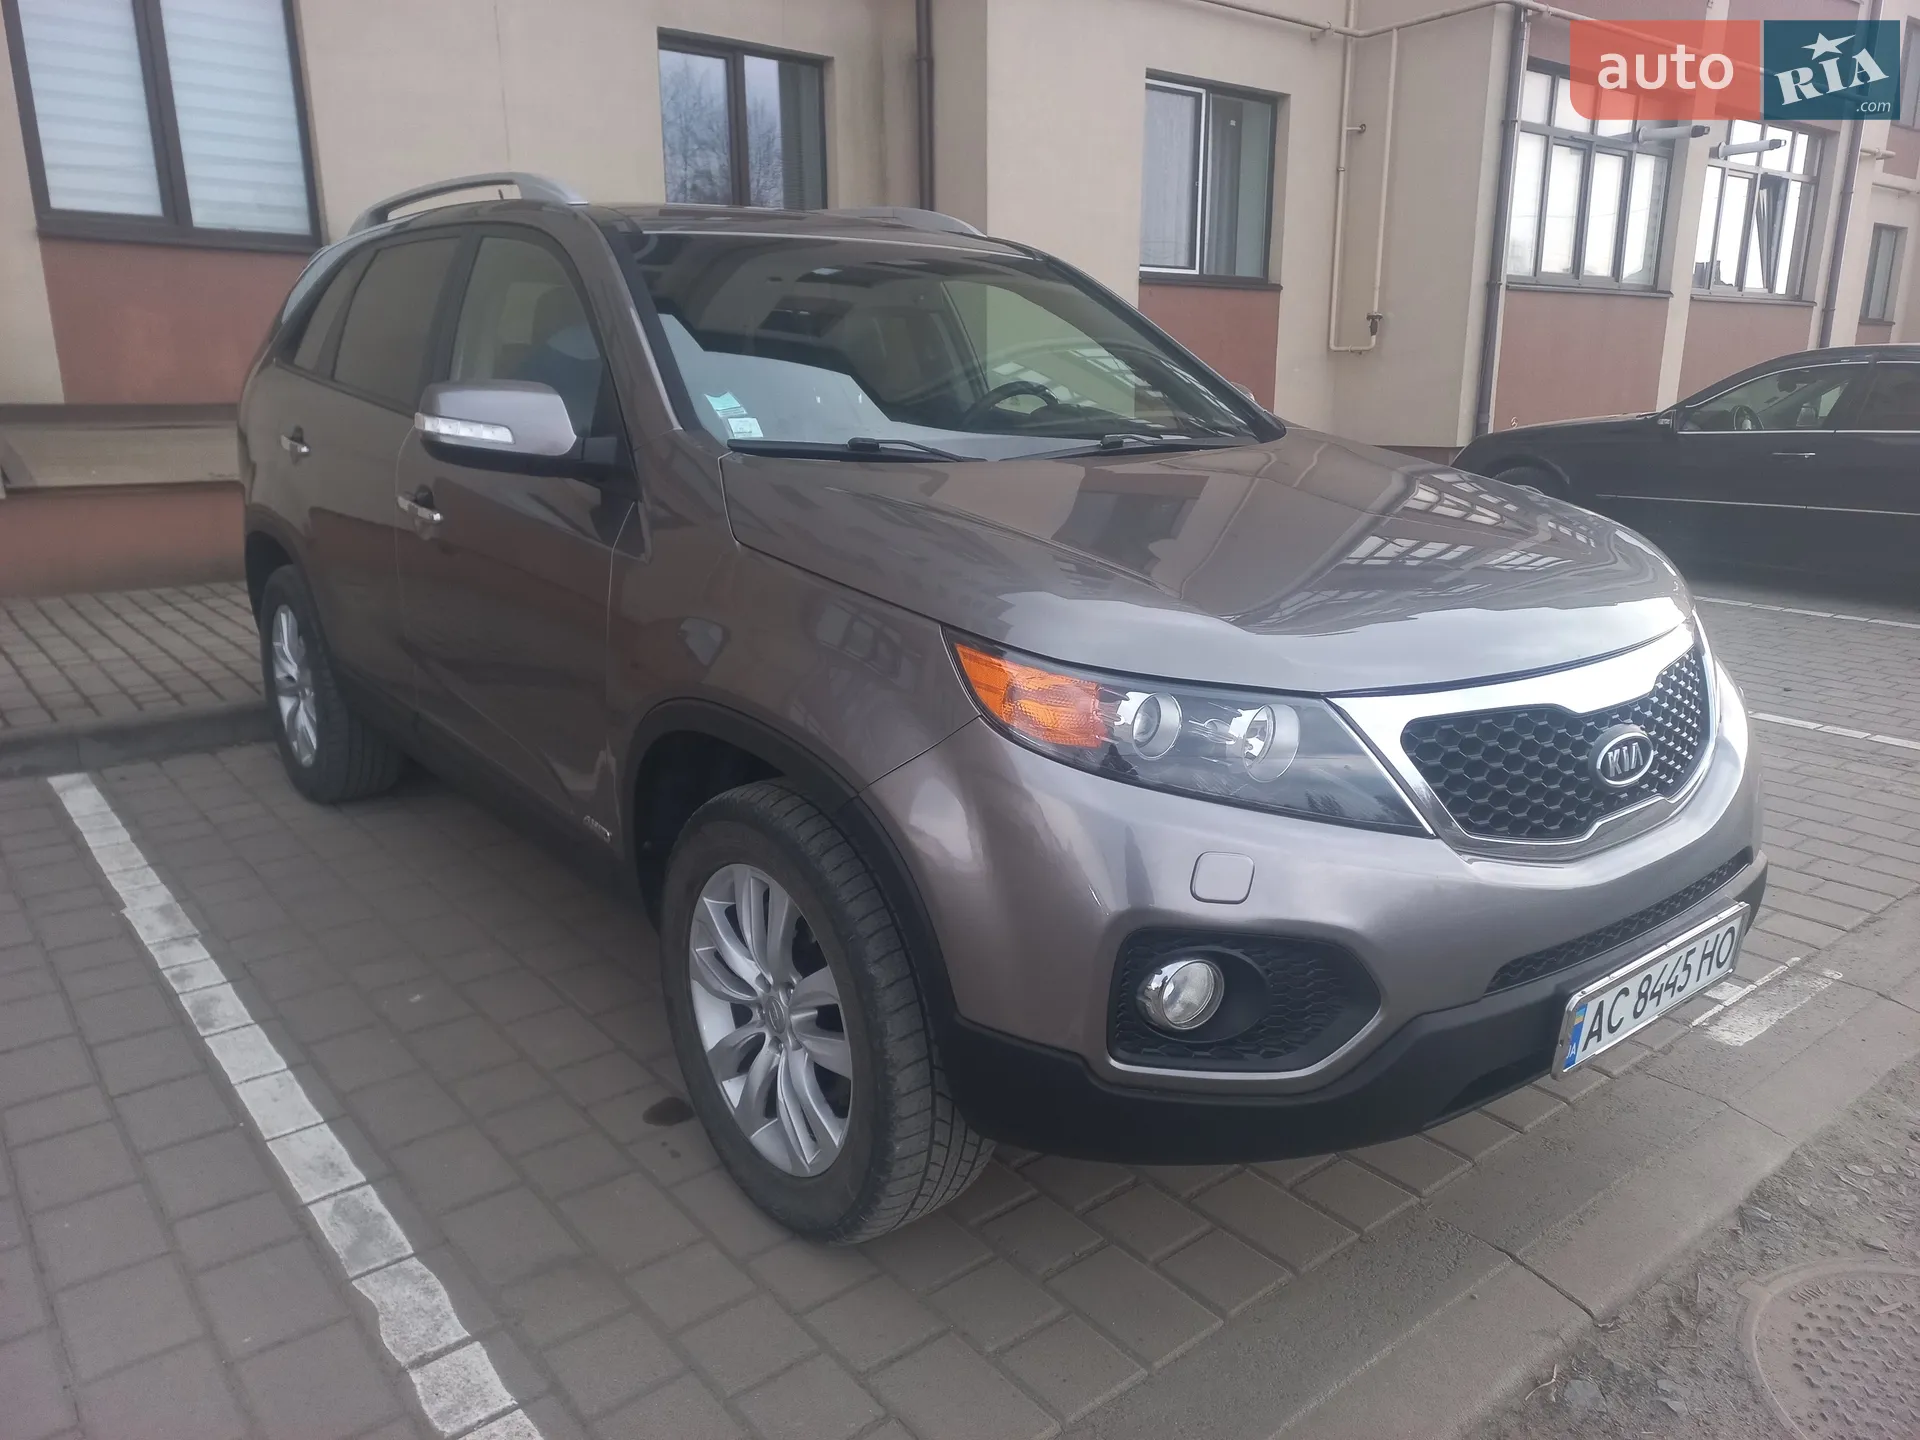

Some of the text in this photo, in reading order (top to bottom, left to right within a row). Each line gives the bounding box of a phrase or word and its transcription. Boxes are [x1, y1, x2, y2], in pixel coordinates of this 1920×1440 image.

[1607, 742, 1643, 777] KIA
[1581, 926, 1736, 1052] AC 8445 HO
